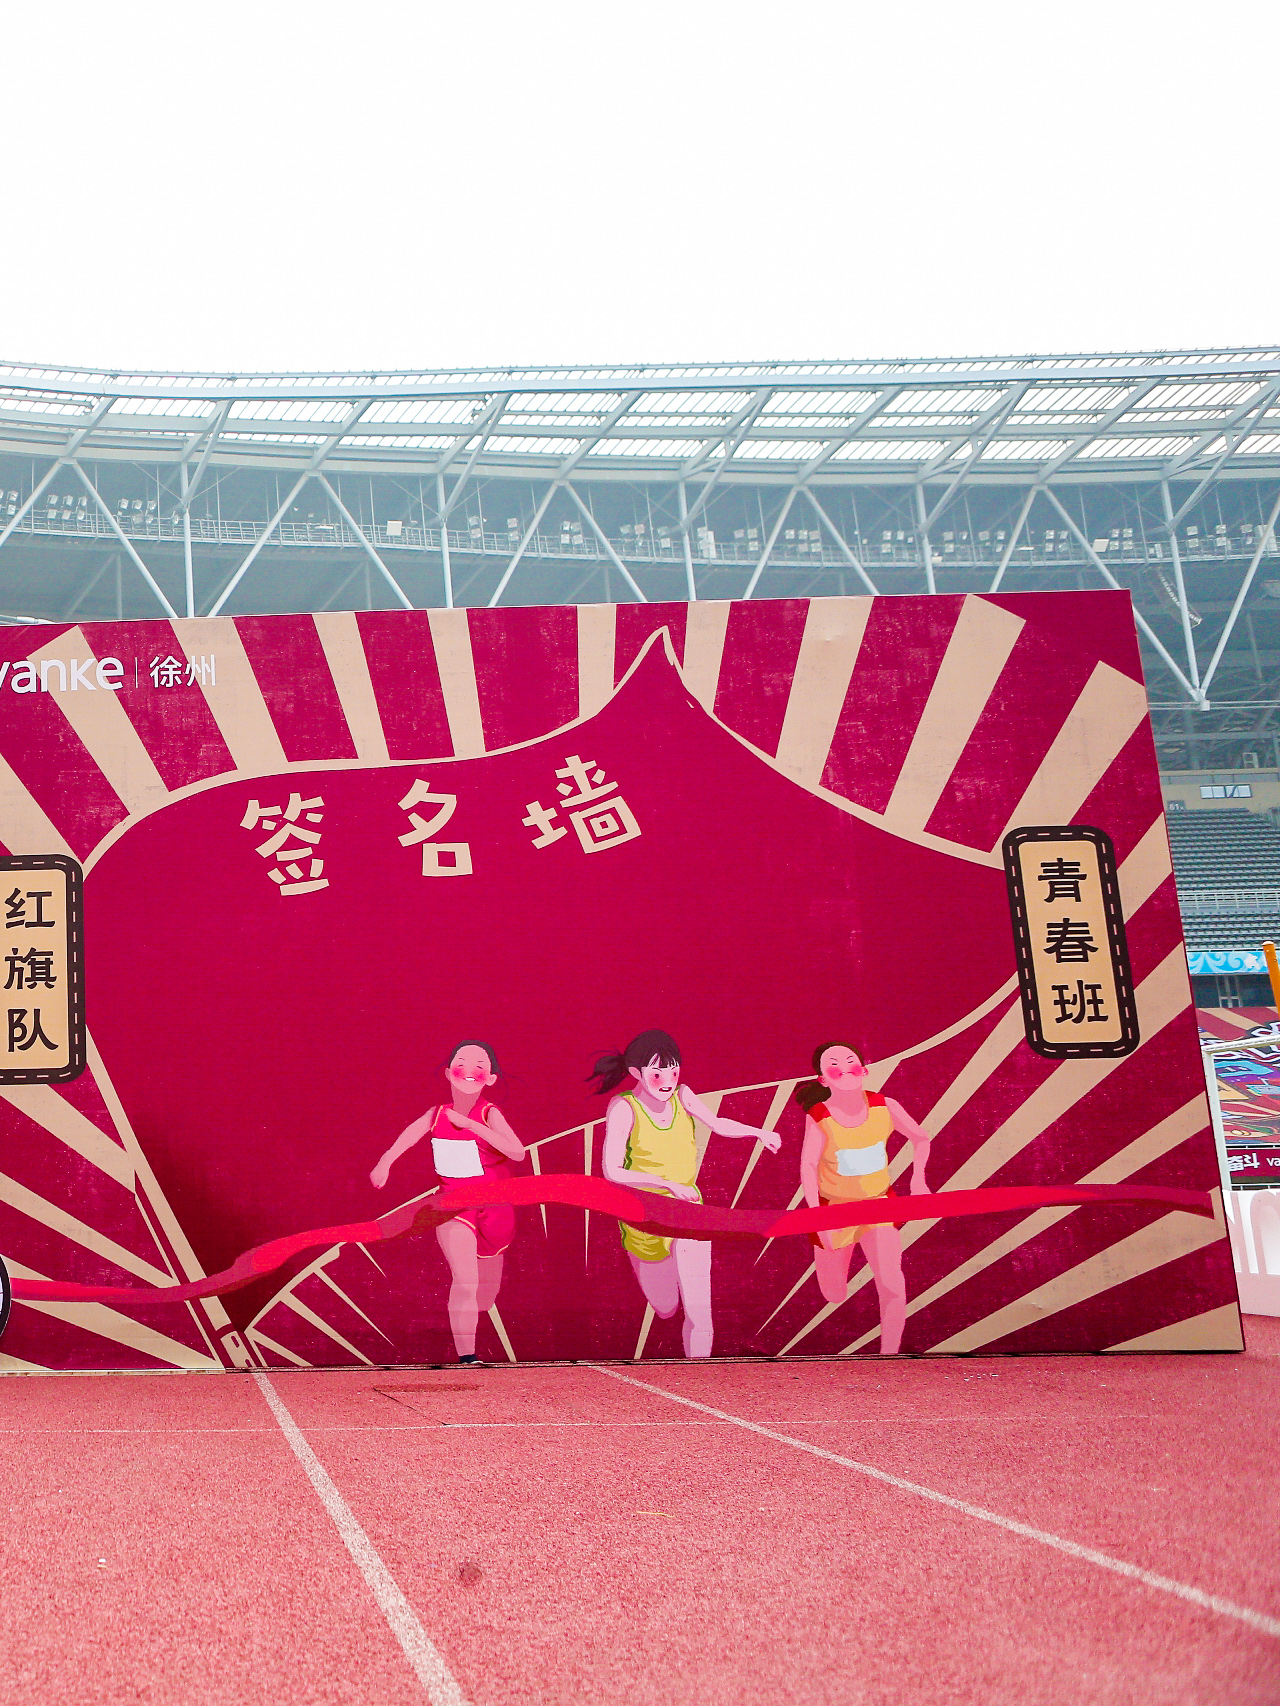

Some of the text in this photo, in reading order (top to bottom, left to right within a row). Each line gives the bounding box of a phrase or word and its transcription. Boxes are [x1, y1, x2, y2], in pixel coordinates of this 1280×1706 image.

[149, 654, 216, 687] 徐州
[240, 755, 641, 896] 签名墙
[3, 888, 59, 1052] 红旗队
[1038, 858, 1108, 1024] 青春班
